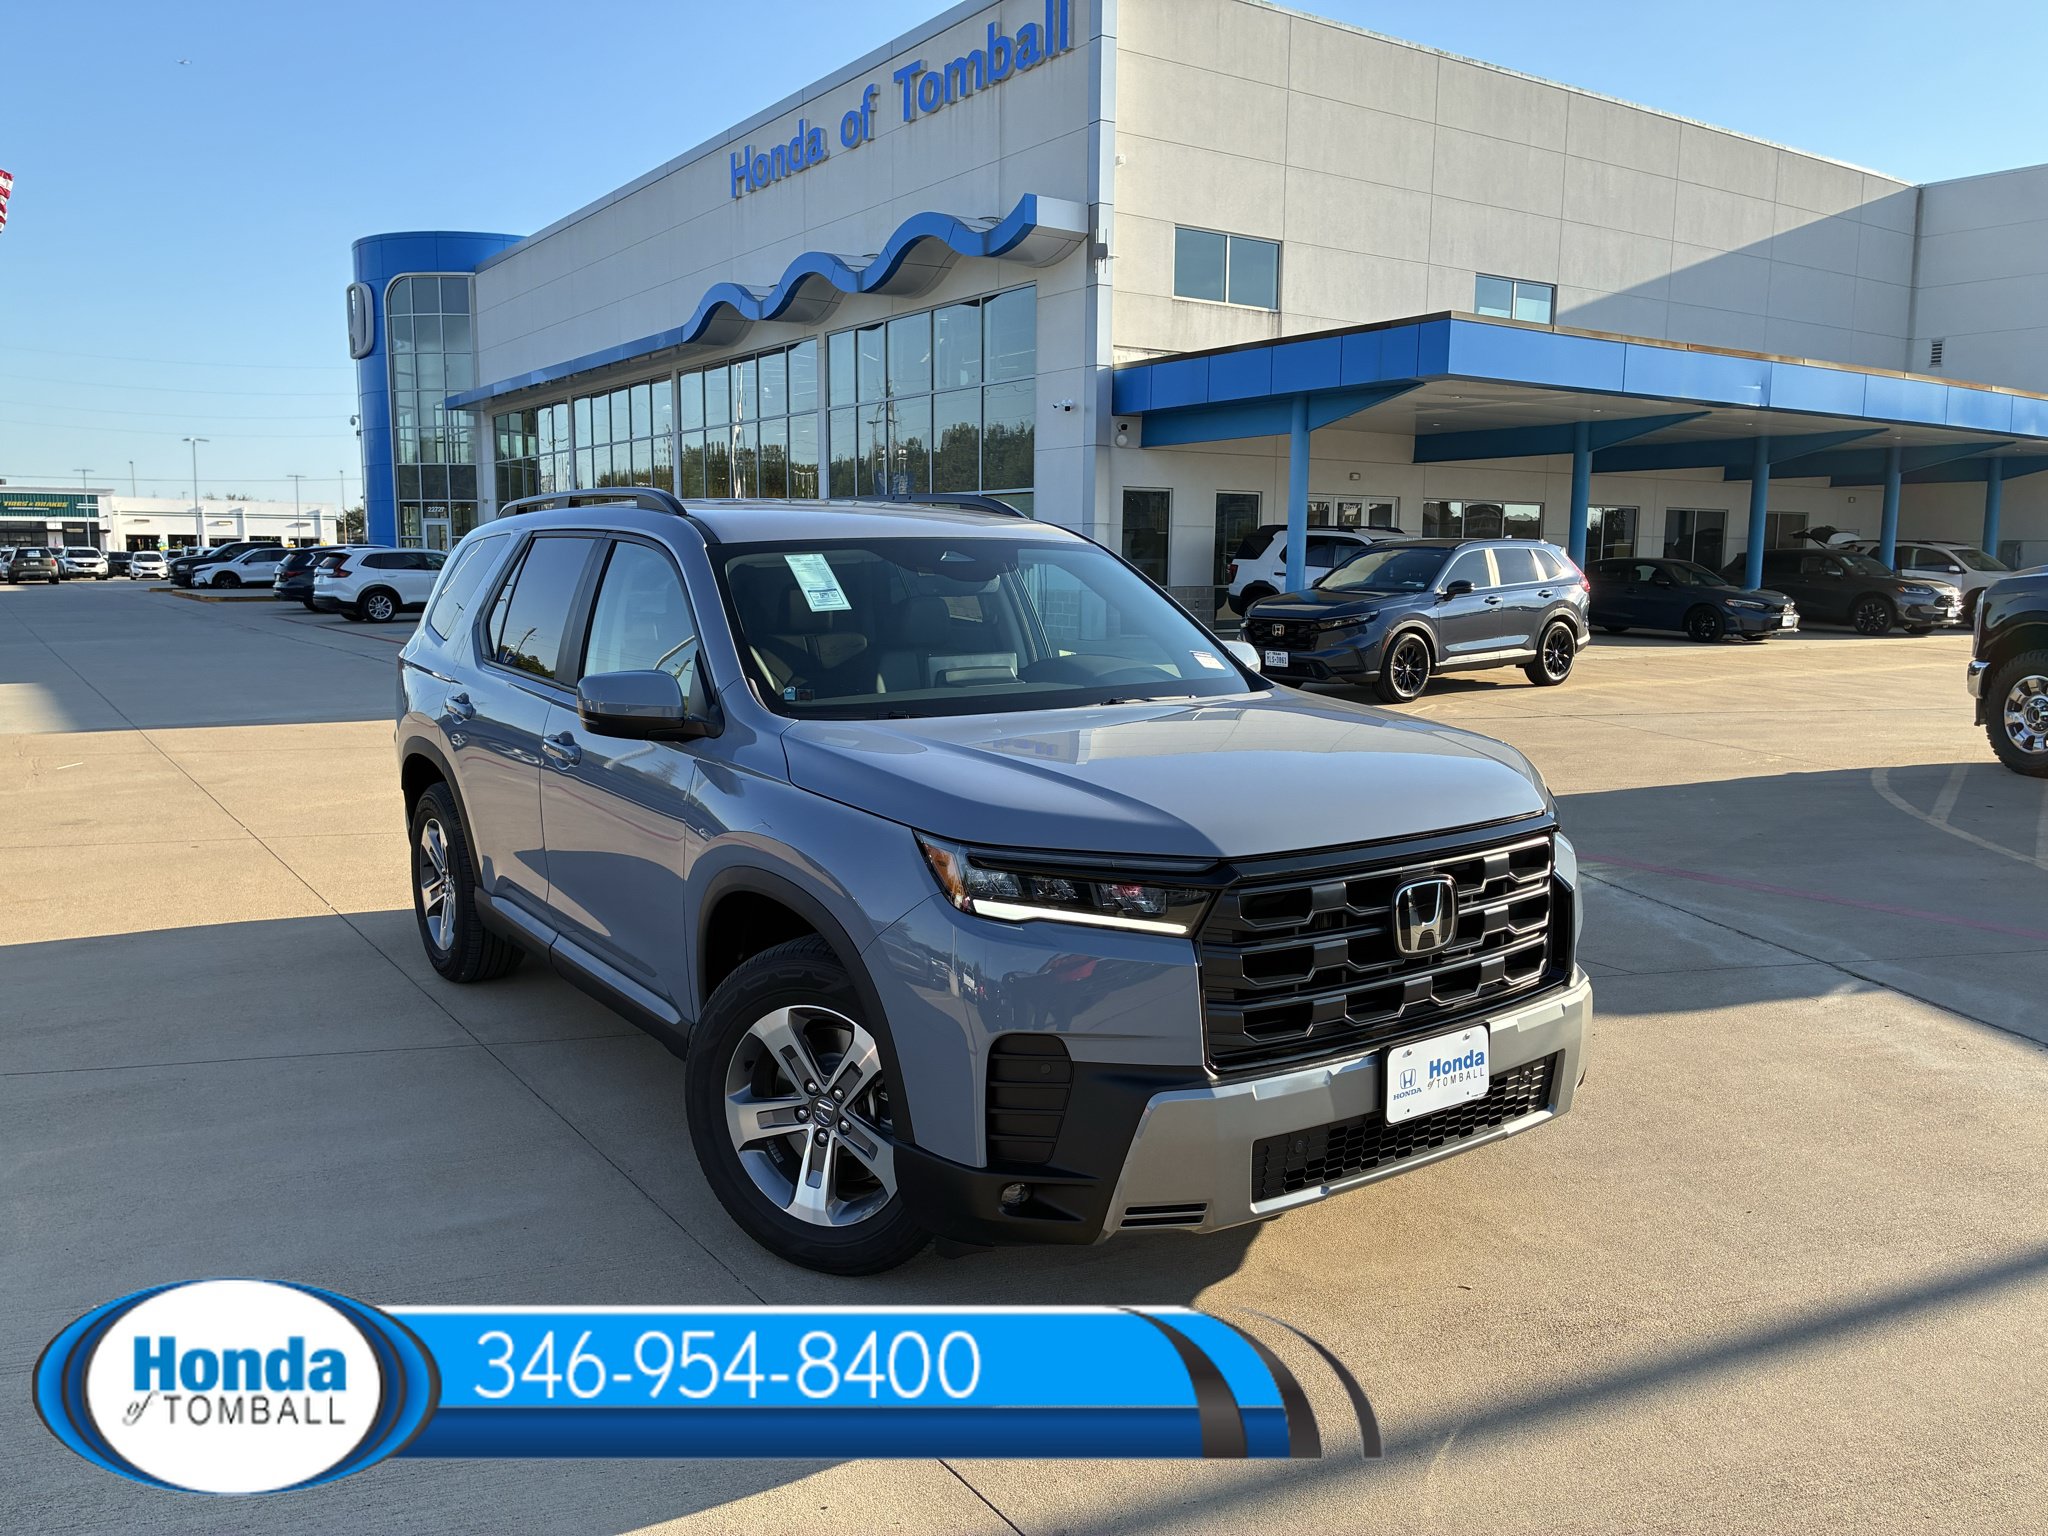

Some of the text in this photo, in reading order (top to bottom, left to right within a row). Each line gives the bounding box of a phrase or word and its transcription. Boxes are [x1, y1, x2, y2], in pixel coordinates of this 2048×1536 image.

[730, 0, 1074, 199] Honda of Tomball
[1429, 1049, 1485, 1079] Honda
[1427, 1067, 1485, 1090] of TOMBALL
[1392, 1087, 1422, 1101] HONDA
